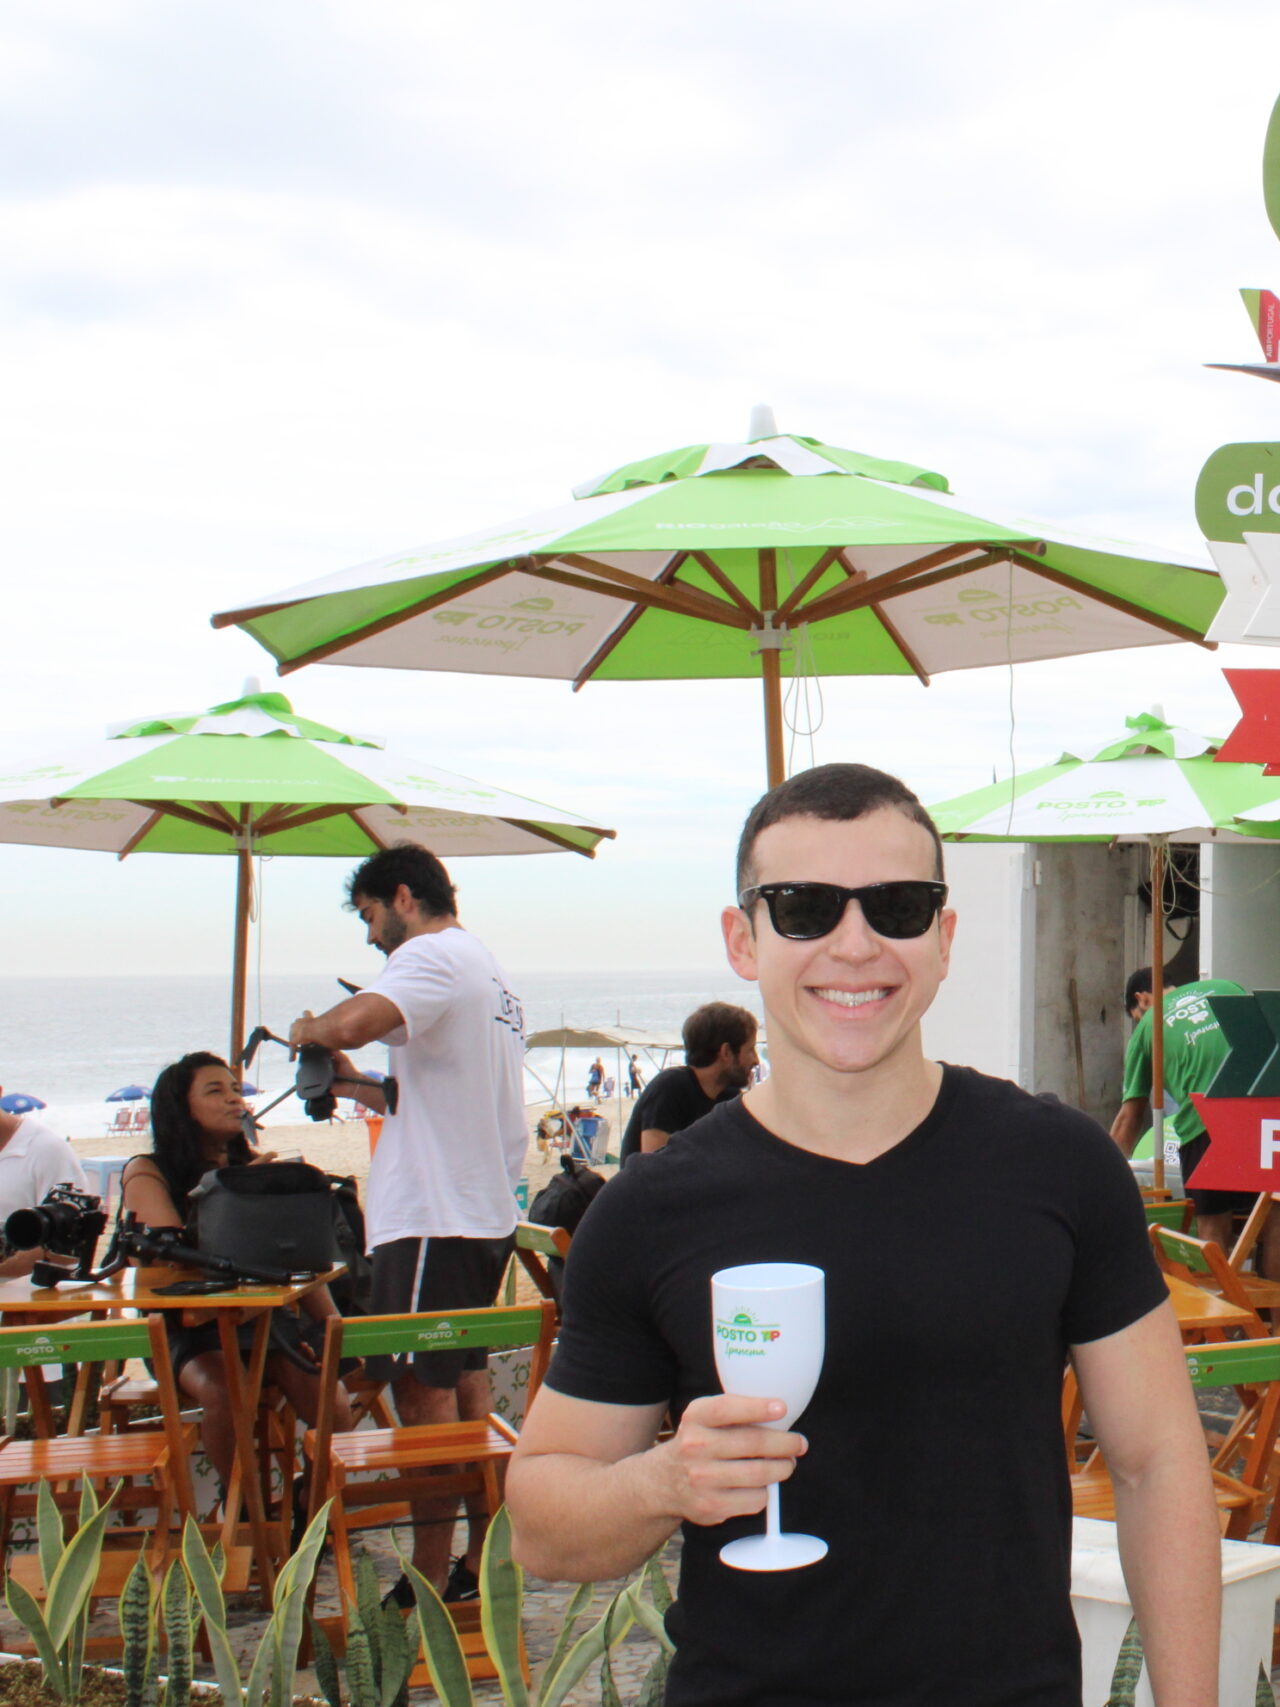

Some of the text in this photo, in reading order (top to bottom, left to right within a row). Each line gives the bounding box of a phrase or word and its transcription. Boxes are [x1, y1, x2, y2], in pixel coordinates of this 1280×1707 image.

[1036, 800, 1127, 810] POSTO
[1165, 1000, 1209, 1028] POST
[417, 1331, 453, 1340] POSTO
[716, 1325, 757, 1342] POSTO
[16, 1345, 54, 1355] POSTO
